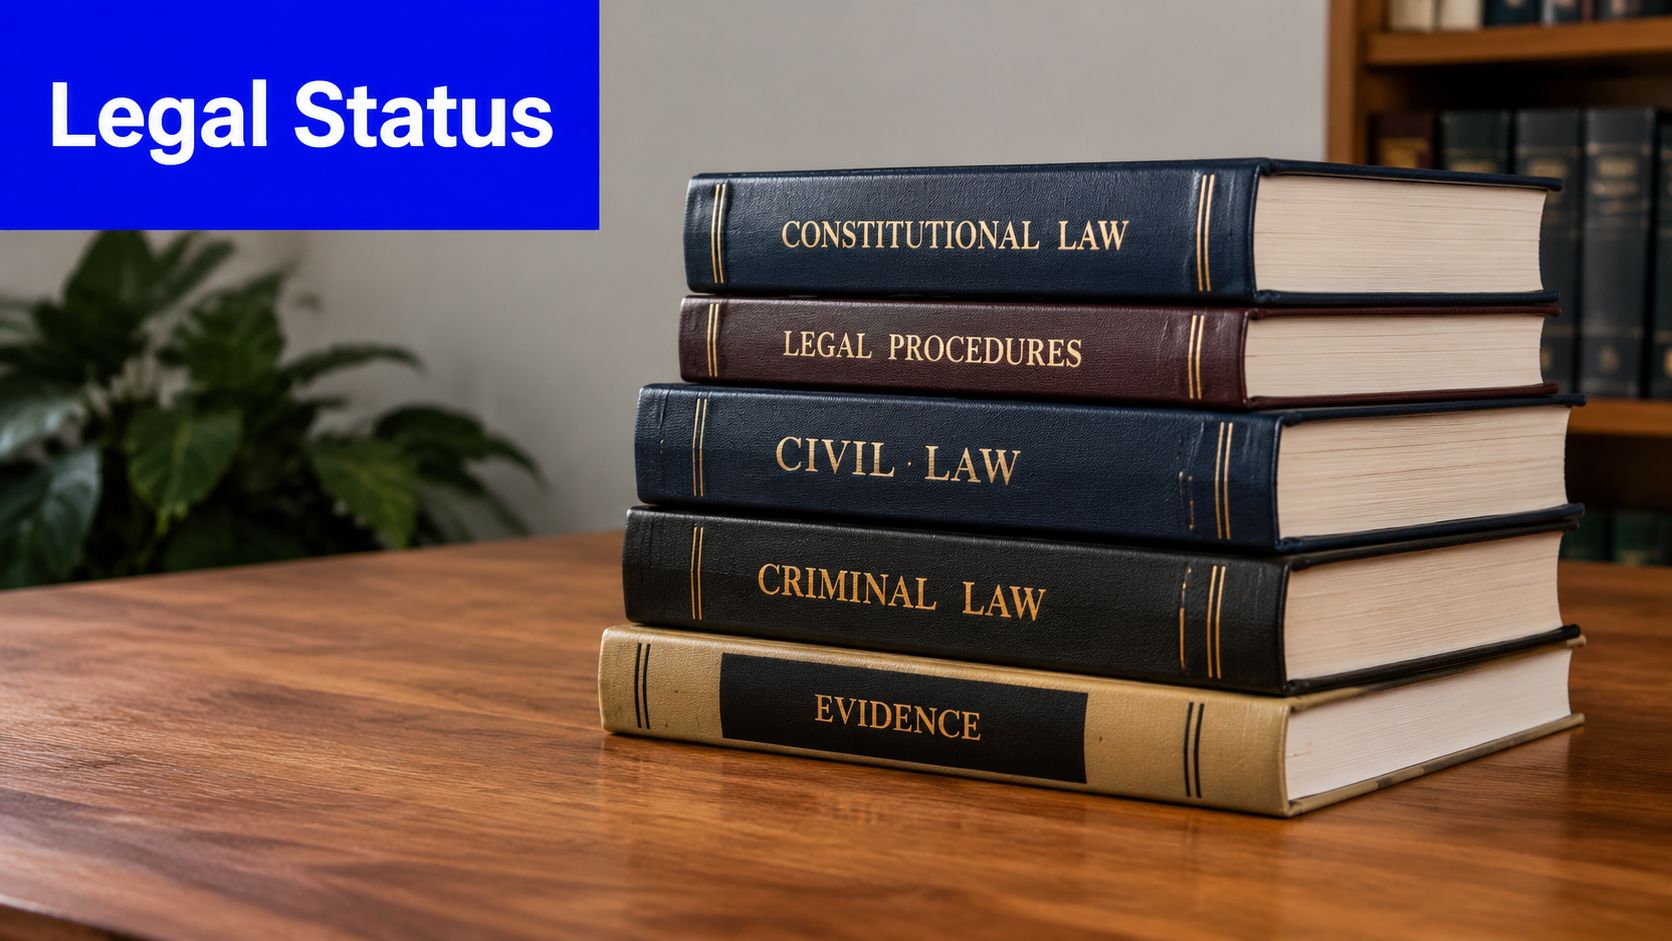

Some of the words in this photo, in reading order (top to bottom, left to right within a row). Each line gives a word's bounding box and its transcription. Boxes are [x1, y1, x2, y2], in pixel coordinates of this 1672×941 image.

[781, 220, 1040, 250] CONSTITUTIONAL
[1057, 219, 1129, 251] LAW
[782, 329, 873, 360] LEGAL
[887, 333, 1084, 369] PROCEDURES
[775, 435, 895, 478] CIVIL
[924, 445, 1022, 485] LAW
[757, 563, 937, 611] CRIMINAL
[962, 581, 1047, 622] LAW
[814, 694, 981, 741] EVIDENCE
